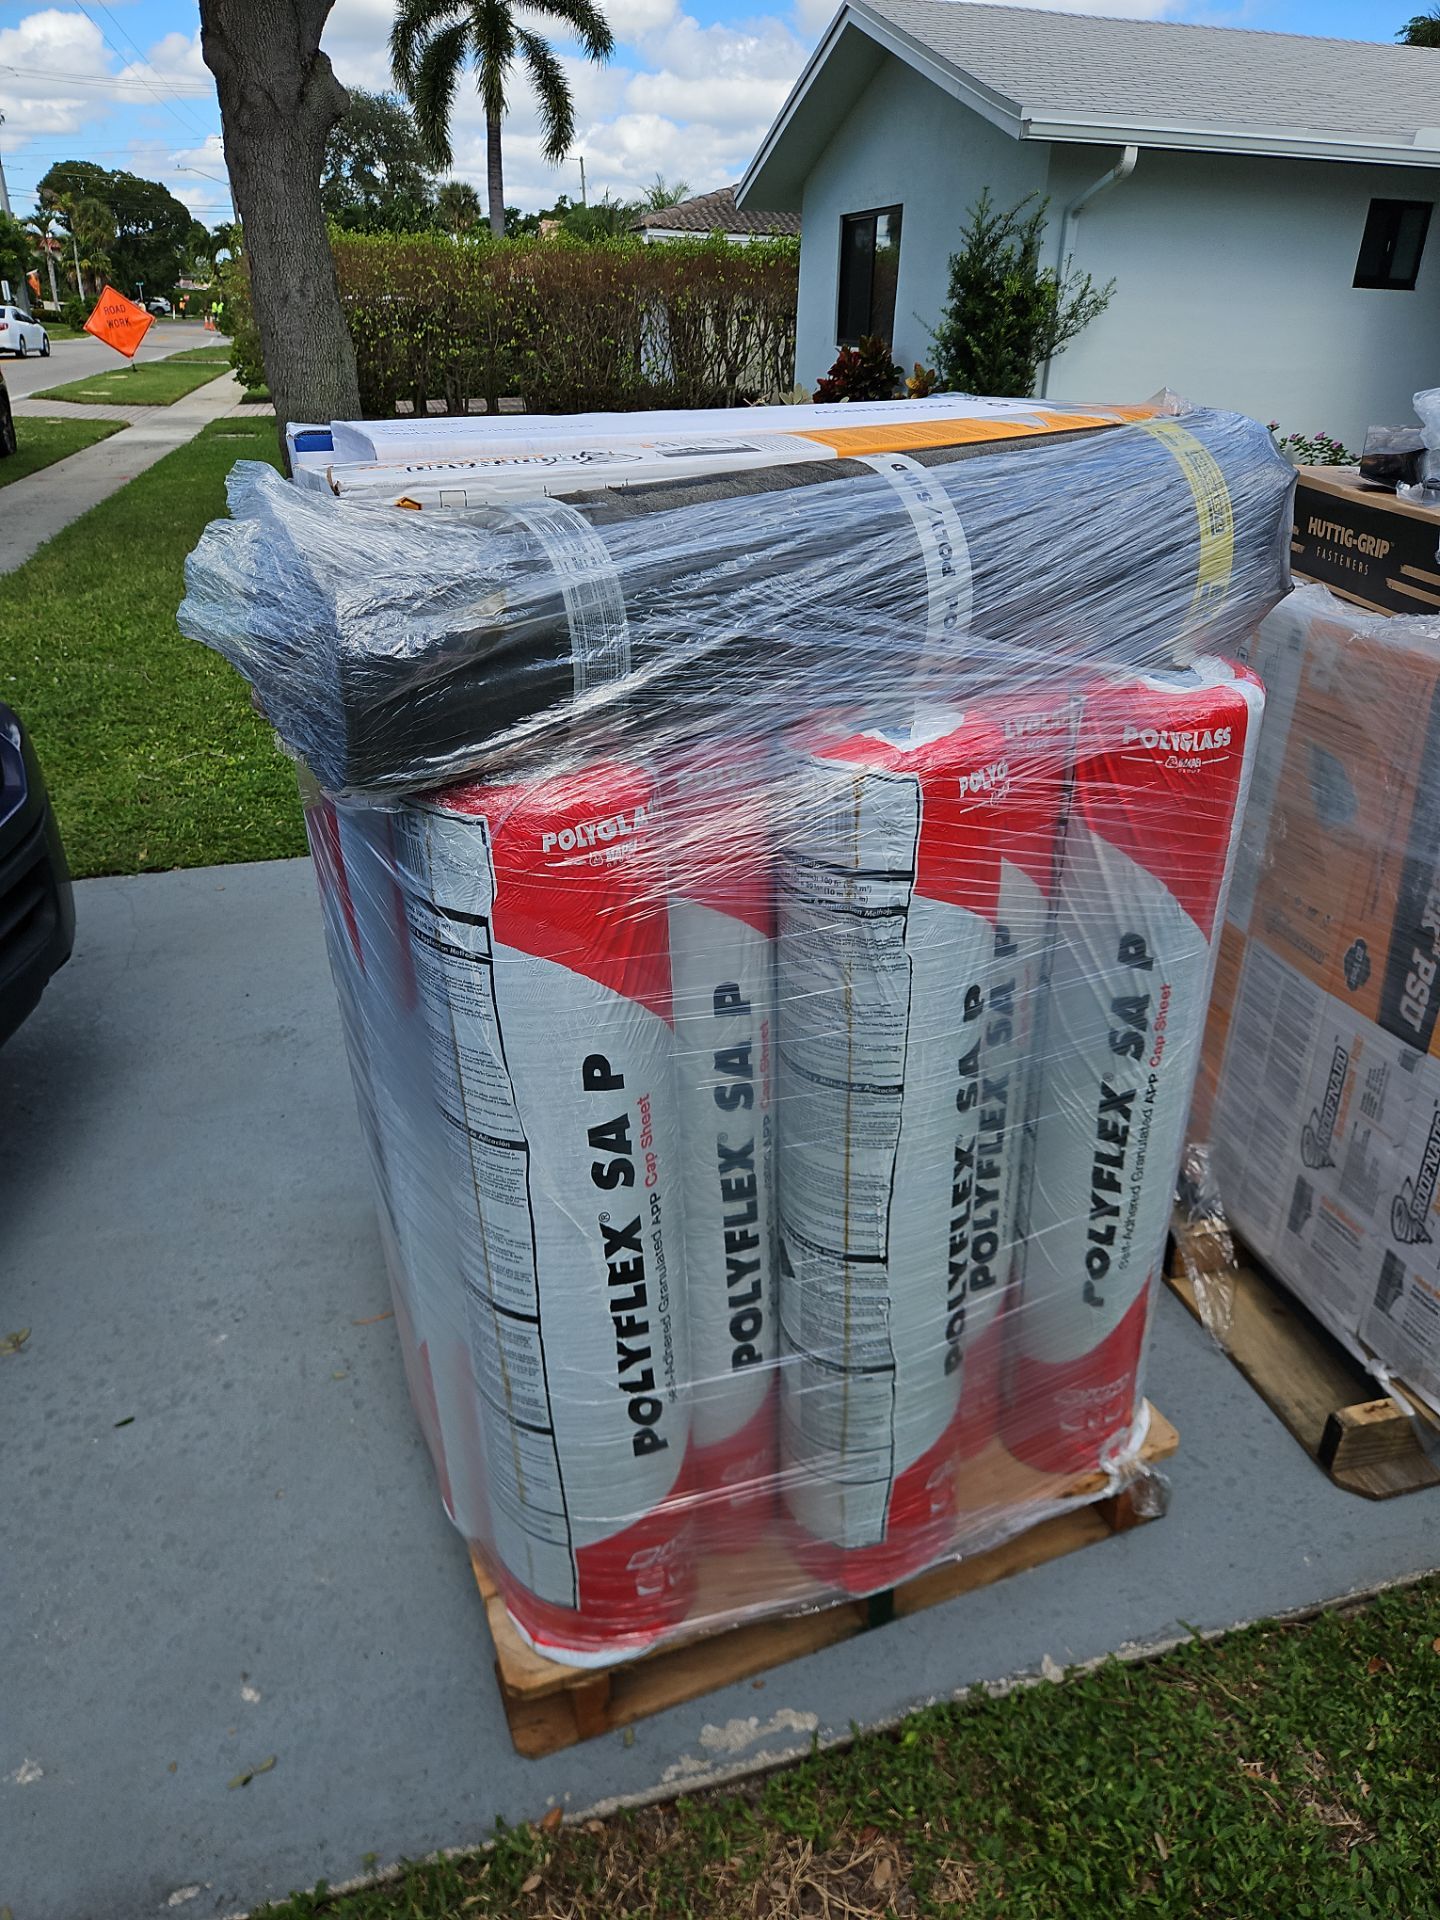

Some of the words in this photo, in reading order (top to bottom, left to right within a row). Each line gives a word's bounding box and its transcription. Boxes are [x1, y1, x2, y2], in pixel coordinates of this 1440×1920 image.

[104, 304, 126, 316] ROAD
[107, 317, 131, 329] WORK
[1307, 516, 1391, 559] HUTTIG-GRIP
[1316, 546, 1369, 576] FASTENERS
[1120, 725, 1232, 753] POLYGLASS
[993, 923, 1018, 958] P
[1117, 930, 1155, 972] P
[713, 981, 752, 1018] P
[963, 982, 986, 1023] P
[1153, 983, 1172, 1035] Sheet
[1400, 947, 1438, 1034] PSU
[985, 976, 1016, 1050] SA
[1107, 992, 1151, 1063] SA
[582, 1053, 625, 1092] P
[1149, 1035, 1166, 1068] Cap
[713, 1037, 754, 1112] SA
[955, 1036, 983, 1114] SA
[1145, 1073, 1160, 1105] APP
[1315, 1046, 1347, 1150] ROOFNADO
[637, 1092, 654, 1148] Sheet
[587, 1112, 636, 1190] SA
[1132, 1107, 1153, 1182] Granulated
[644, 1152, 659, 1189] Cap
[969, 1073, 1010, 1294] POLYFLEX
[649, 1192, 662, 1225] APP
[651, 1230, 670, 1313] Granulated
